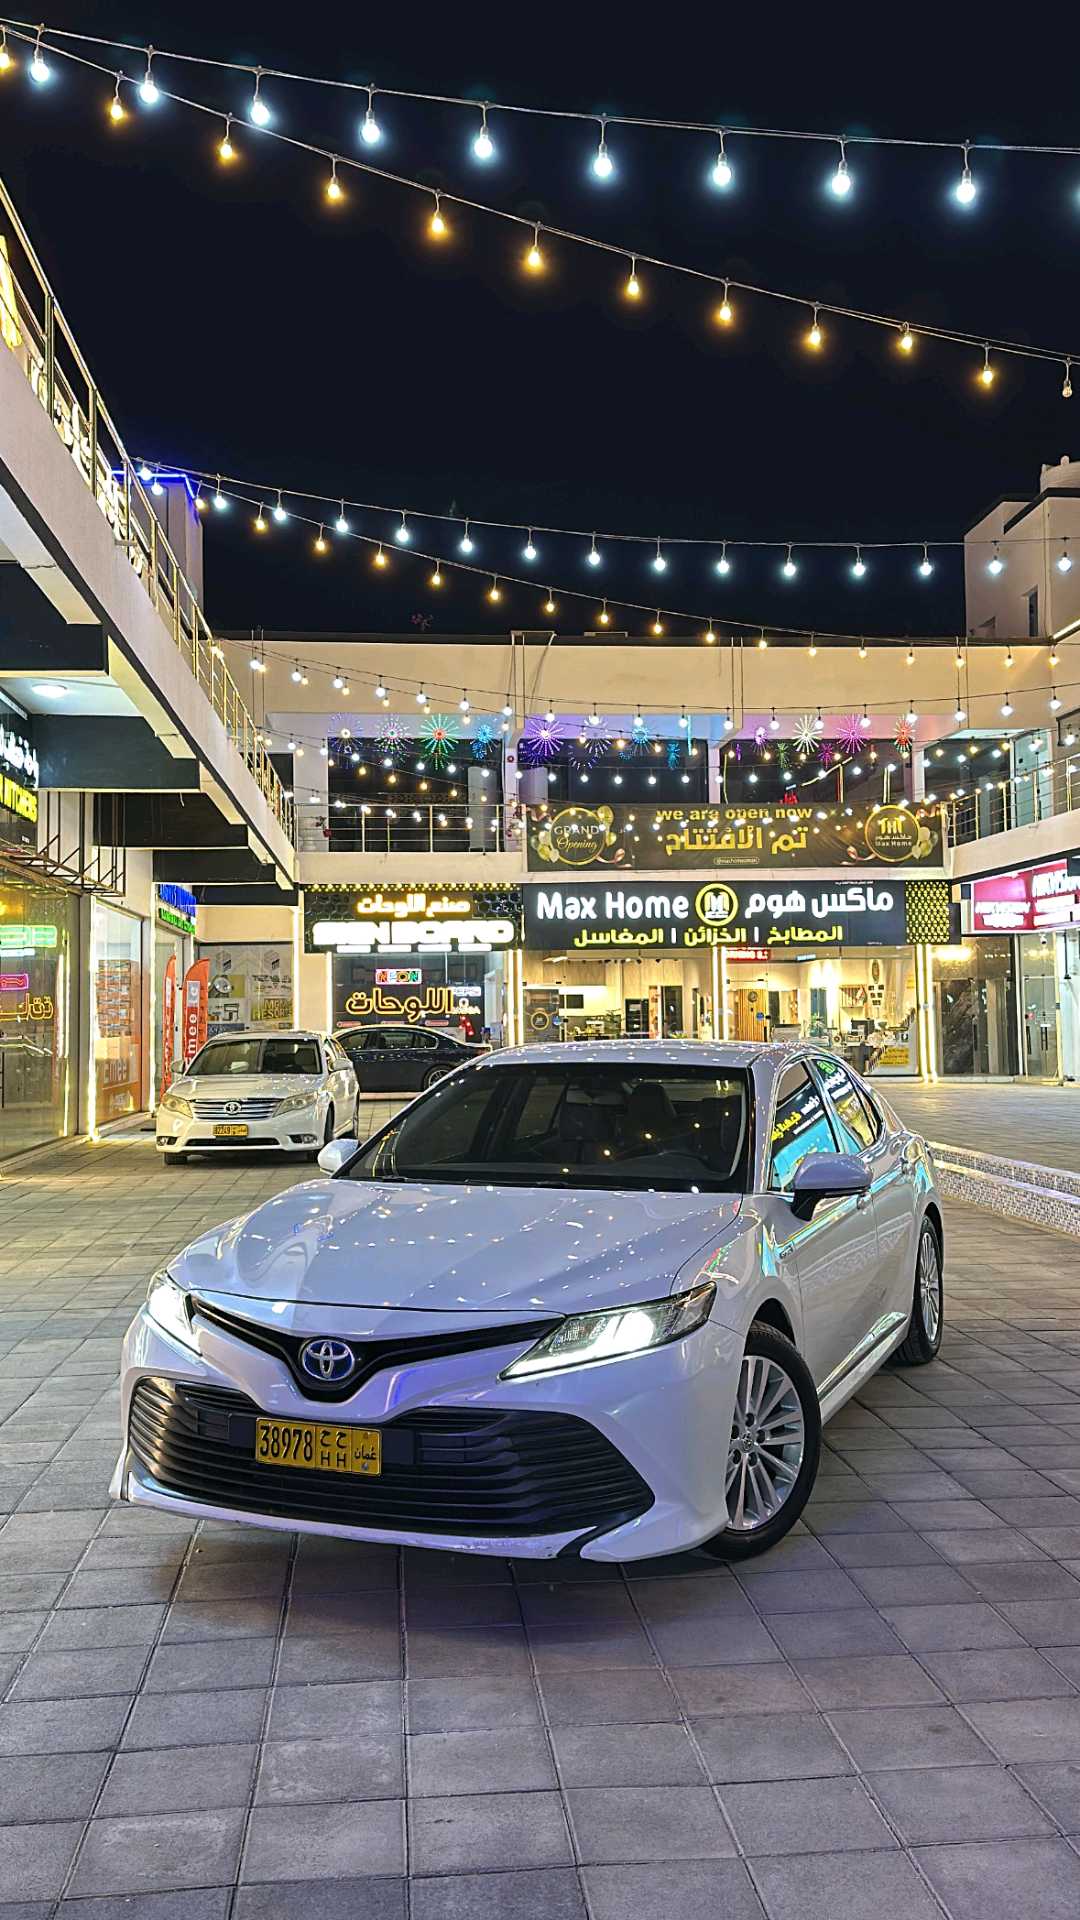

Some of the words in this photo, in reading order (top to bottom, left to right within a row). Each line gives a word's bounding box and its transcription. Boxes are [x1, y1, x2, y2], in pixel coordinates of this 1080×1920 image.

[654, 809, 684, 820] we
[689, 809, 720, 821] are
[725, 808, 769, 822] open
[775, 807, 813, 820] now
[771, 826, 809, 855] تم
[537, 891, 598, 920] Max
[604, 891, 689, 920] Home
[744, 889, 806, 919] هوم
[811, 886, 894, 919] ماكس
[573, 927, 664, 948] المغاسل
[683, 926, 747, 947] الخزائن
[766, 925, 843, 945] المطابخ
[346, 986, 454, 1023] اللوحات
[259, 1424, 313, 1462] 38978
